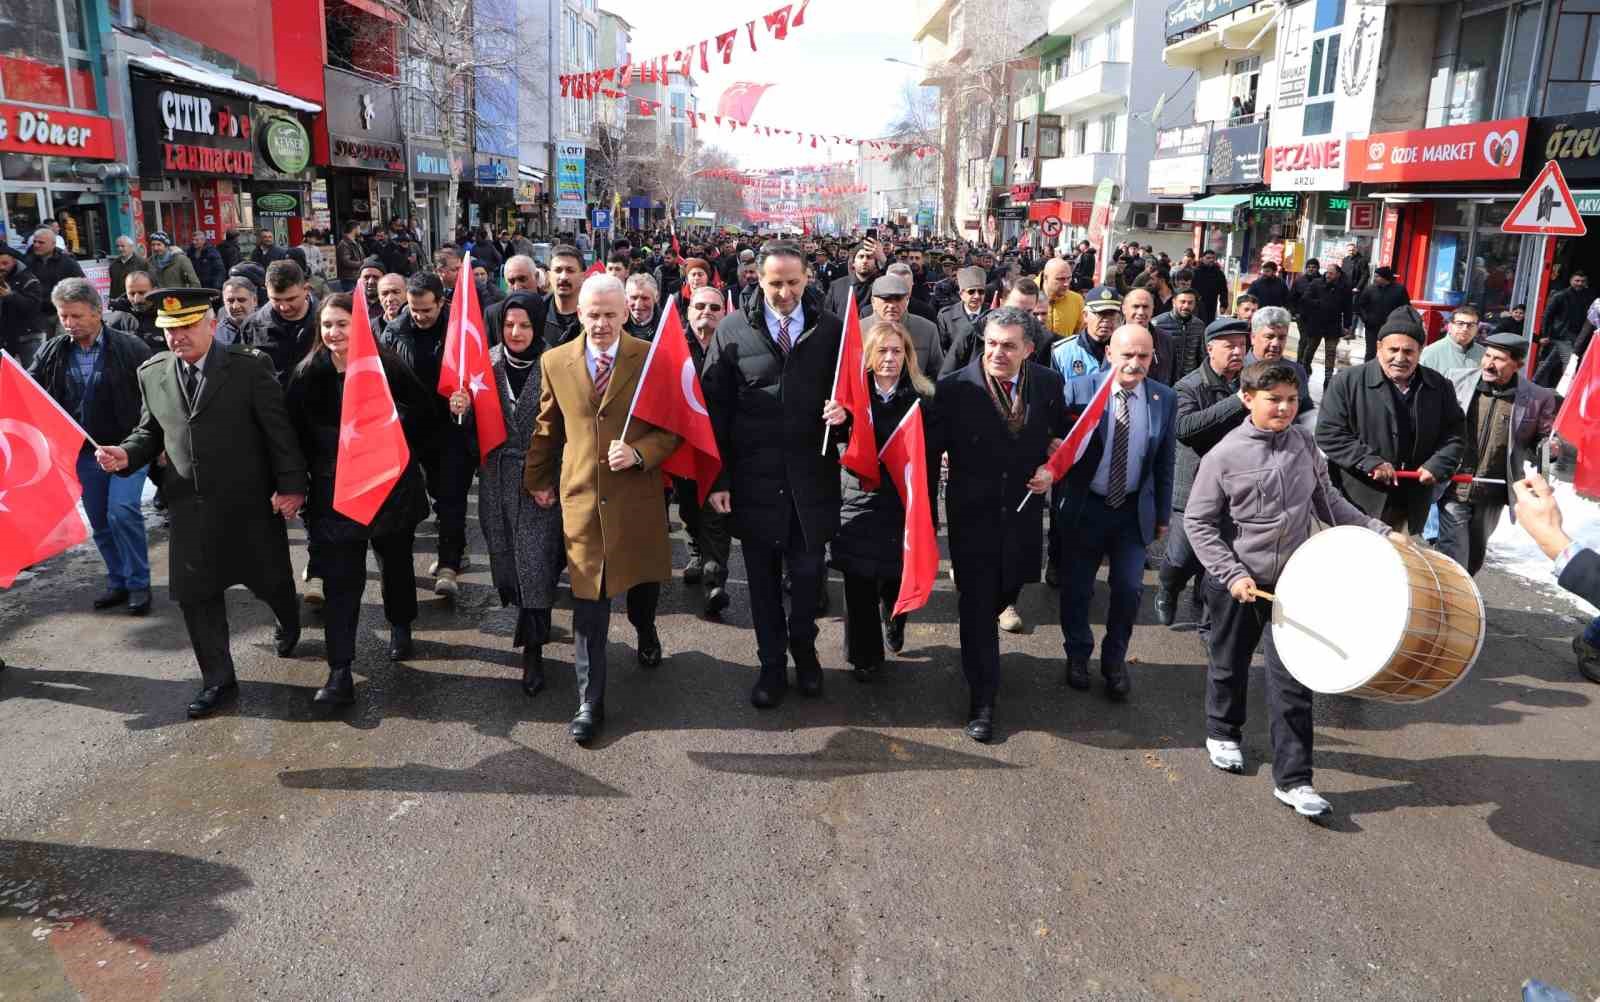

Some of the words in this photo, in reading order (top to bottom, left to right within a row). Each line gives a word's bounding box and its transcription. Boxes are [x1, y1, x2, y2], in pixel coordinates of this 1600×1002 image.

[162, 90, 214, 141] ÇITIR
[19, 111, 91, 148] Döner
[1273, 140, 1341, 171] ECZANE
[1422, 141, 1477, 163] MARKET
[1294, 176, 1315, 186] ARZU
[1254, 195, 1295, 208] KAHVE
[595, 211, 607, 227] P
